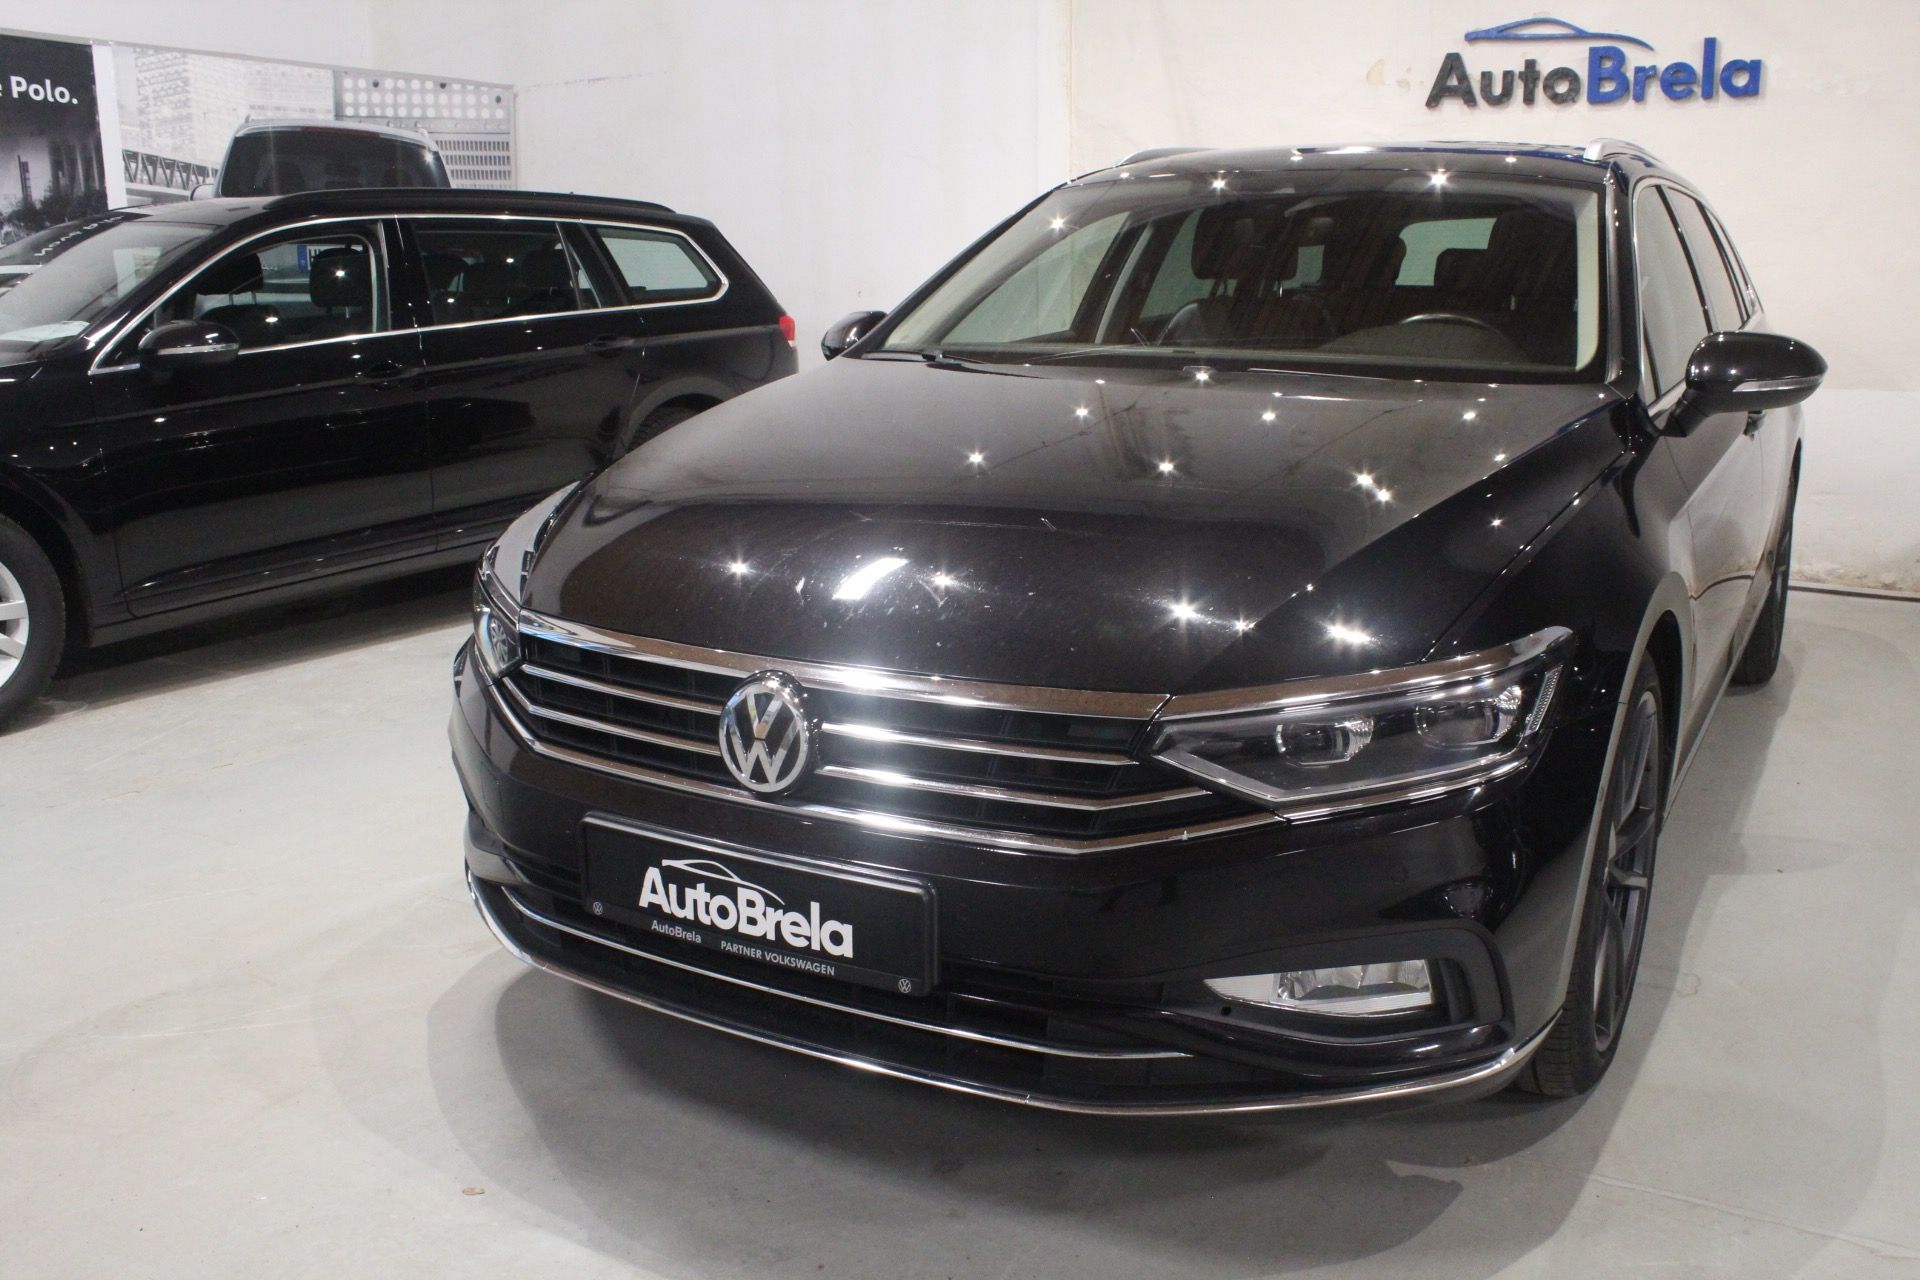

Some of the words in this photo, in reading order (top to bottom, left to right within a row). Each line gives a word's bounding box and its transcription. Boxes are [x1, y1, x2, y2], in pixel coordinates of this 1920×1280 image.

[10, 75, 78, 104] Polo.
[1425, 37, 1762, 108] AutoBrela
[638, 866, 853, 958] AutoBrela
[651, 920, 702, 943] AutoBrela
[720, 940, 762, 959] PARTNER
[764, 952, 835, 976] VOLKSWAGEN
